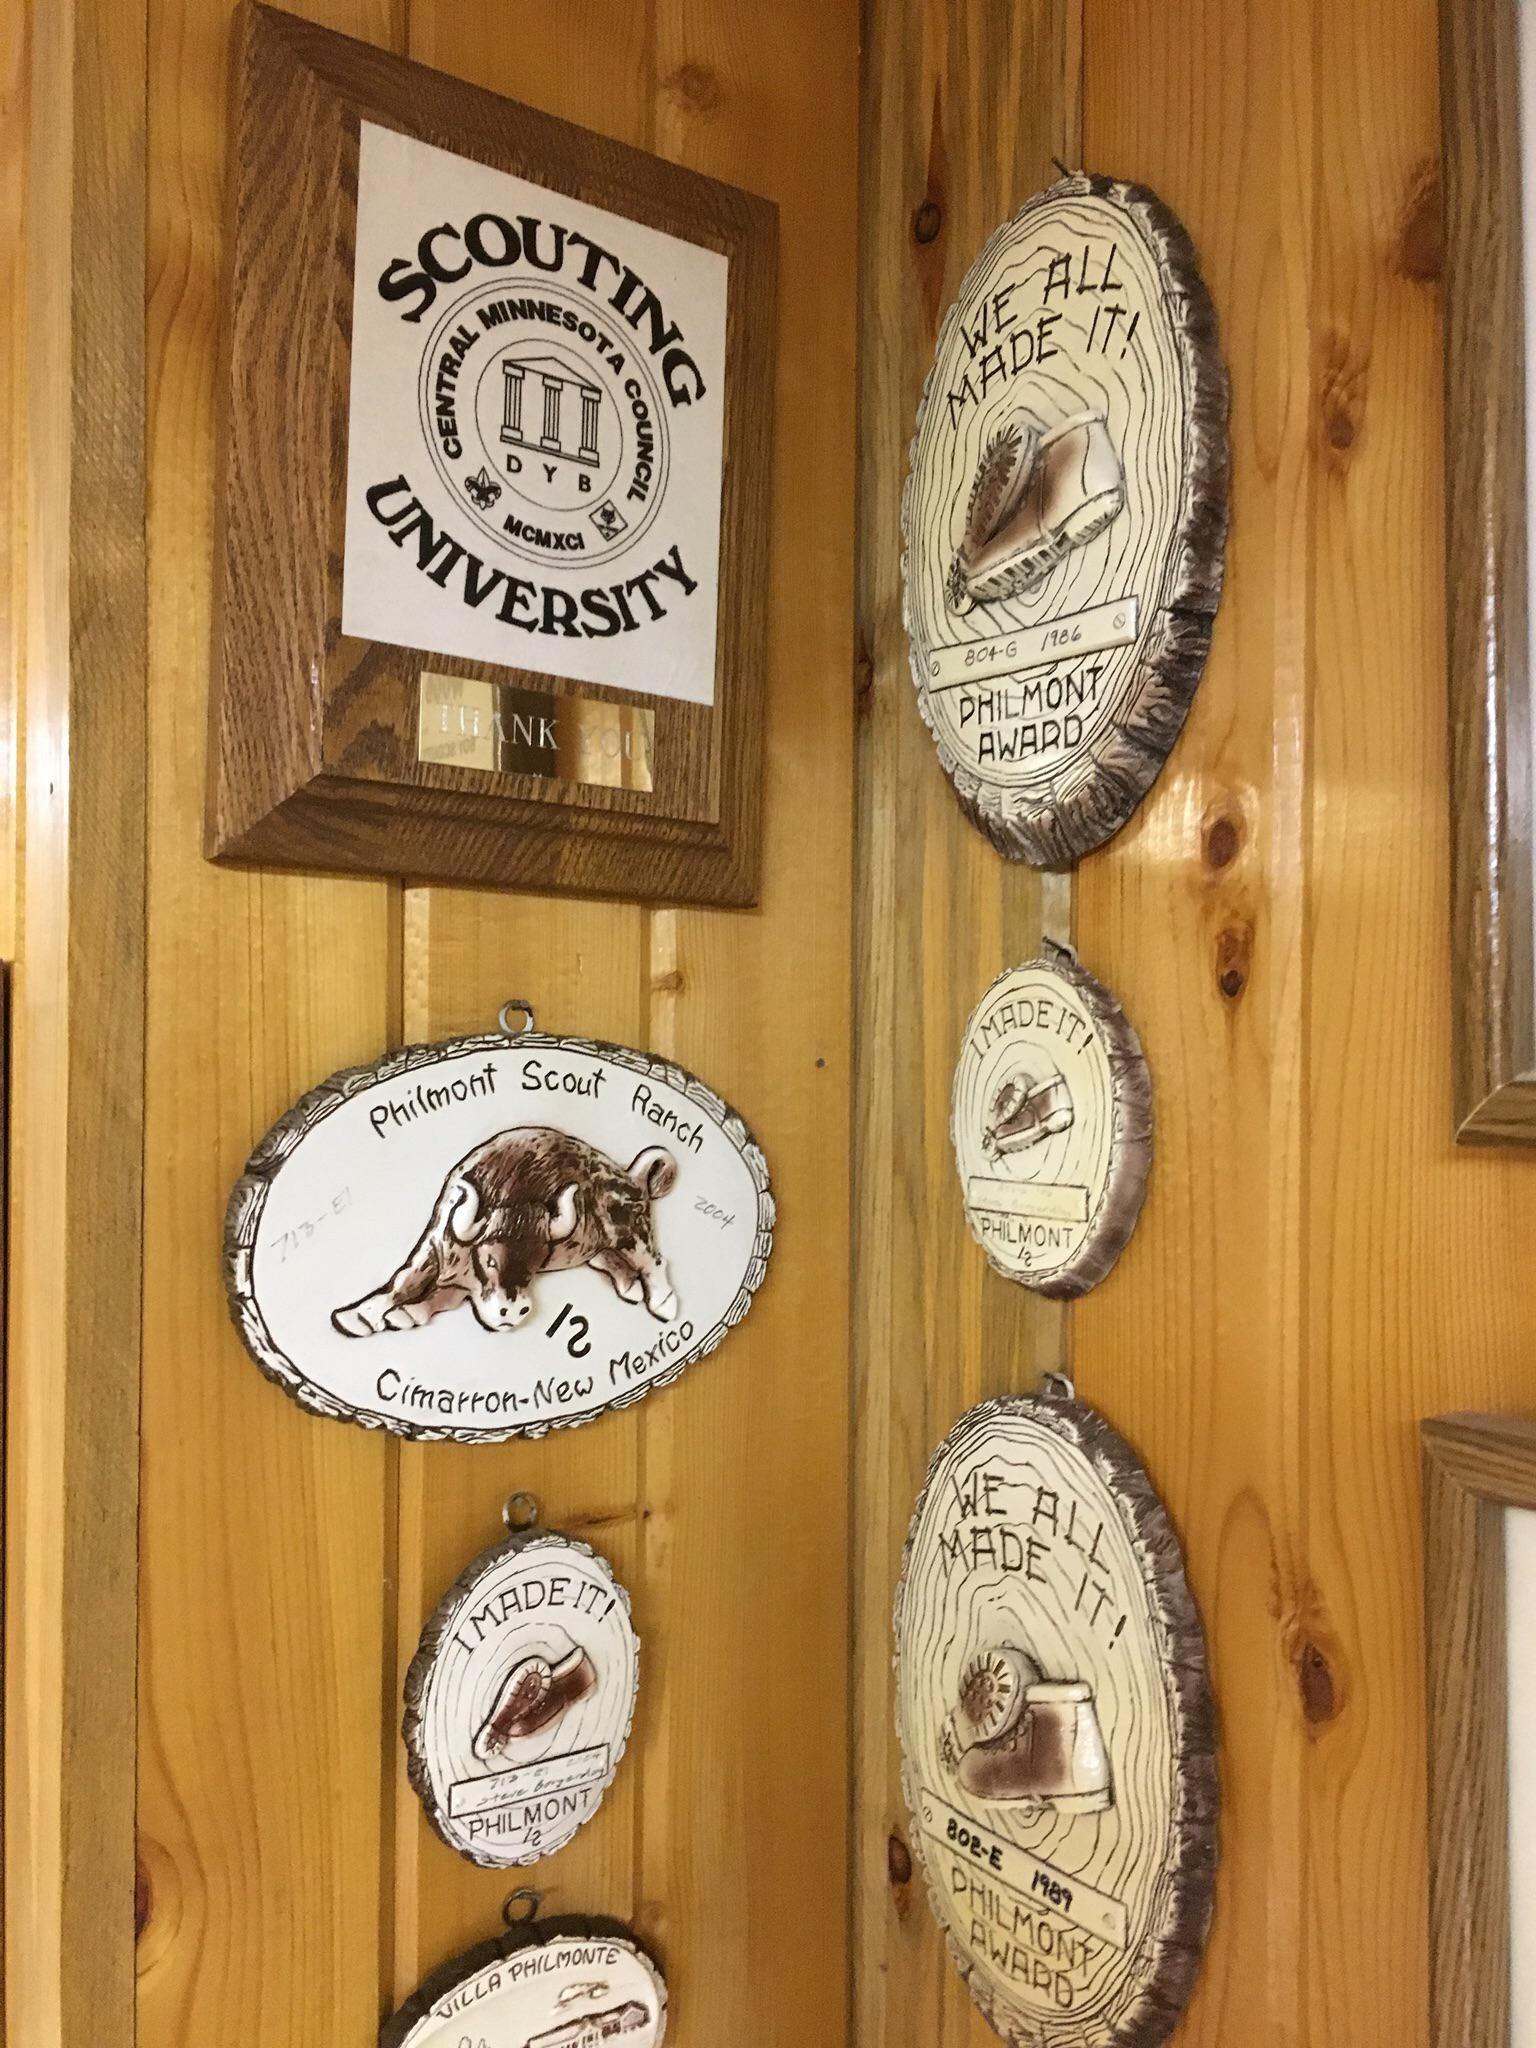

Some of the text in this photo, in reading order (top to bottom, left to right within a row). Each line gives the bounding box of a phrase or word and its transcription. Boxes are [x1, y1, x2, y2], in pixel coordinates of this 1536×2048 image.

[378, 213, 707, 408] SCOUTING
[960, 243, 1122, 358] WE ALL
[435, 297, 654, 503] CENTRAL MINNESOTA COUNCIL
[947, 304, 1140, 430] MADE IT!
[506, 457, 593, 493] D Y B
[366, 474, 698, 639] UNIVERSITY
[503, 513, 585, 551] MCMXCI
[1041, 624, 1082, 651] 1986
[959, 665, 1103, 729] PHILMONT
[978, 714, 1083, 765] AWARD
[980, 1000, 1054, 1050] MADE
[368, 1060, 706, 1155] Philmont Scout Ranch
[693, 1194, 736, 1231] 2004
[981, 1217, 1074, 1248] PHILMONT
[609, 1320, 695, 1386] Mexico
[951, 1471, 1110, 1575] WE ALL
[470, 1577, 571, 1640] MADE
[938, 1526, 1127, 1651] MADE IT!
[468, 1788, 593, 1841] PHILMONT
[952, 1867, 1096, 1977] PHILMONT
[1030, 1869, 1074, 1912] 1989
[435, 1946, 621, 2018] VILLA PHILMONTE
[969, 1918, 1075, 2009] AWARD
